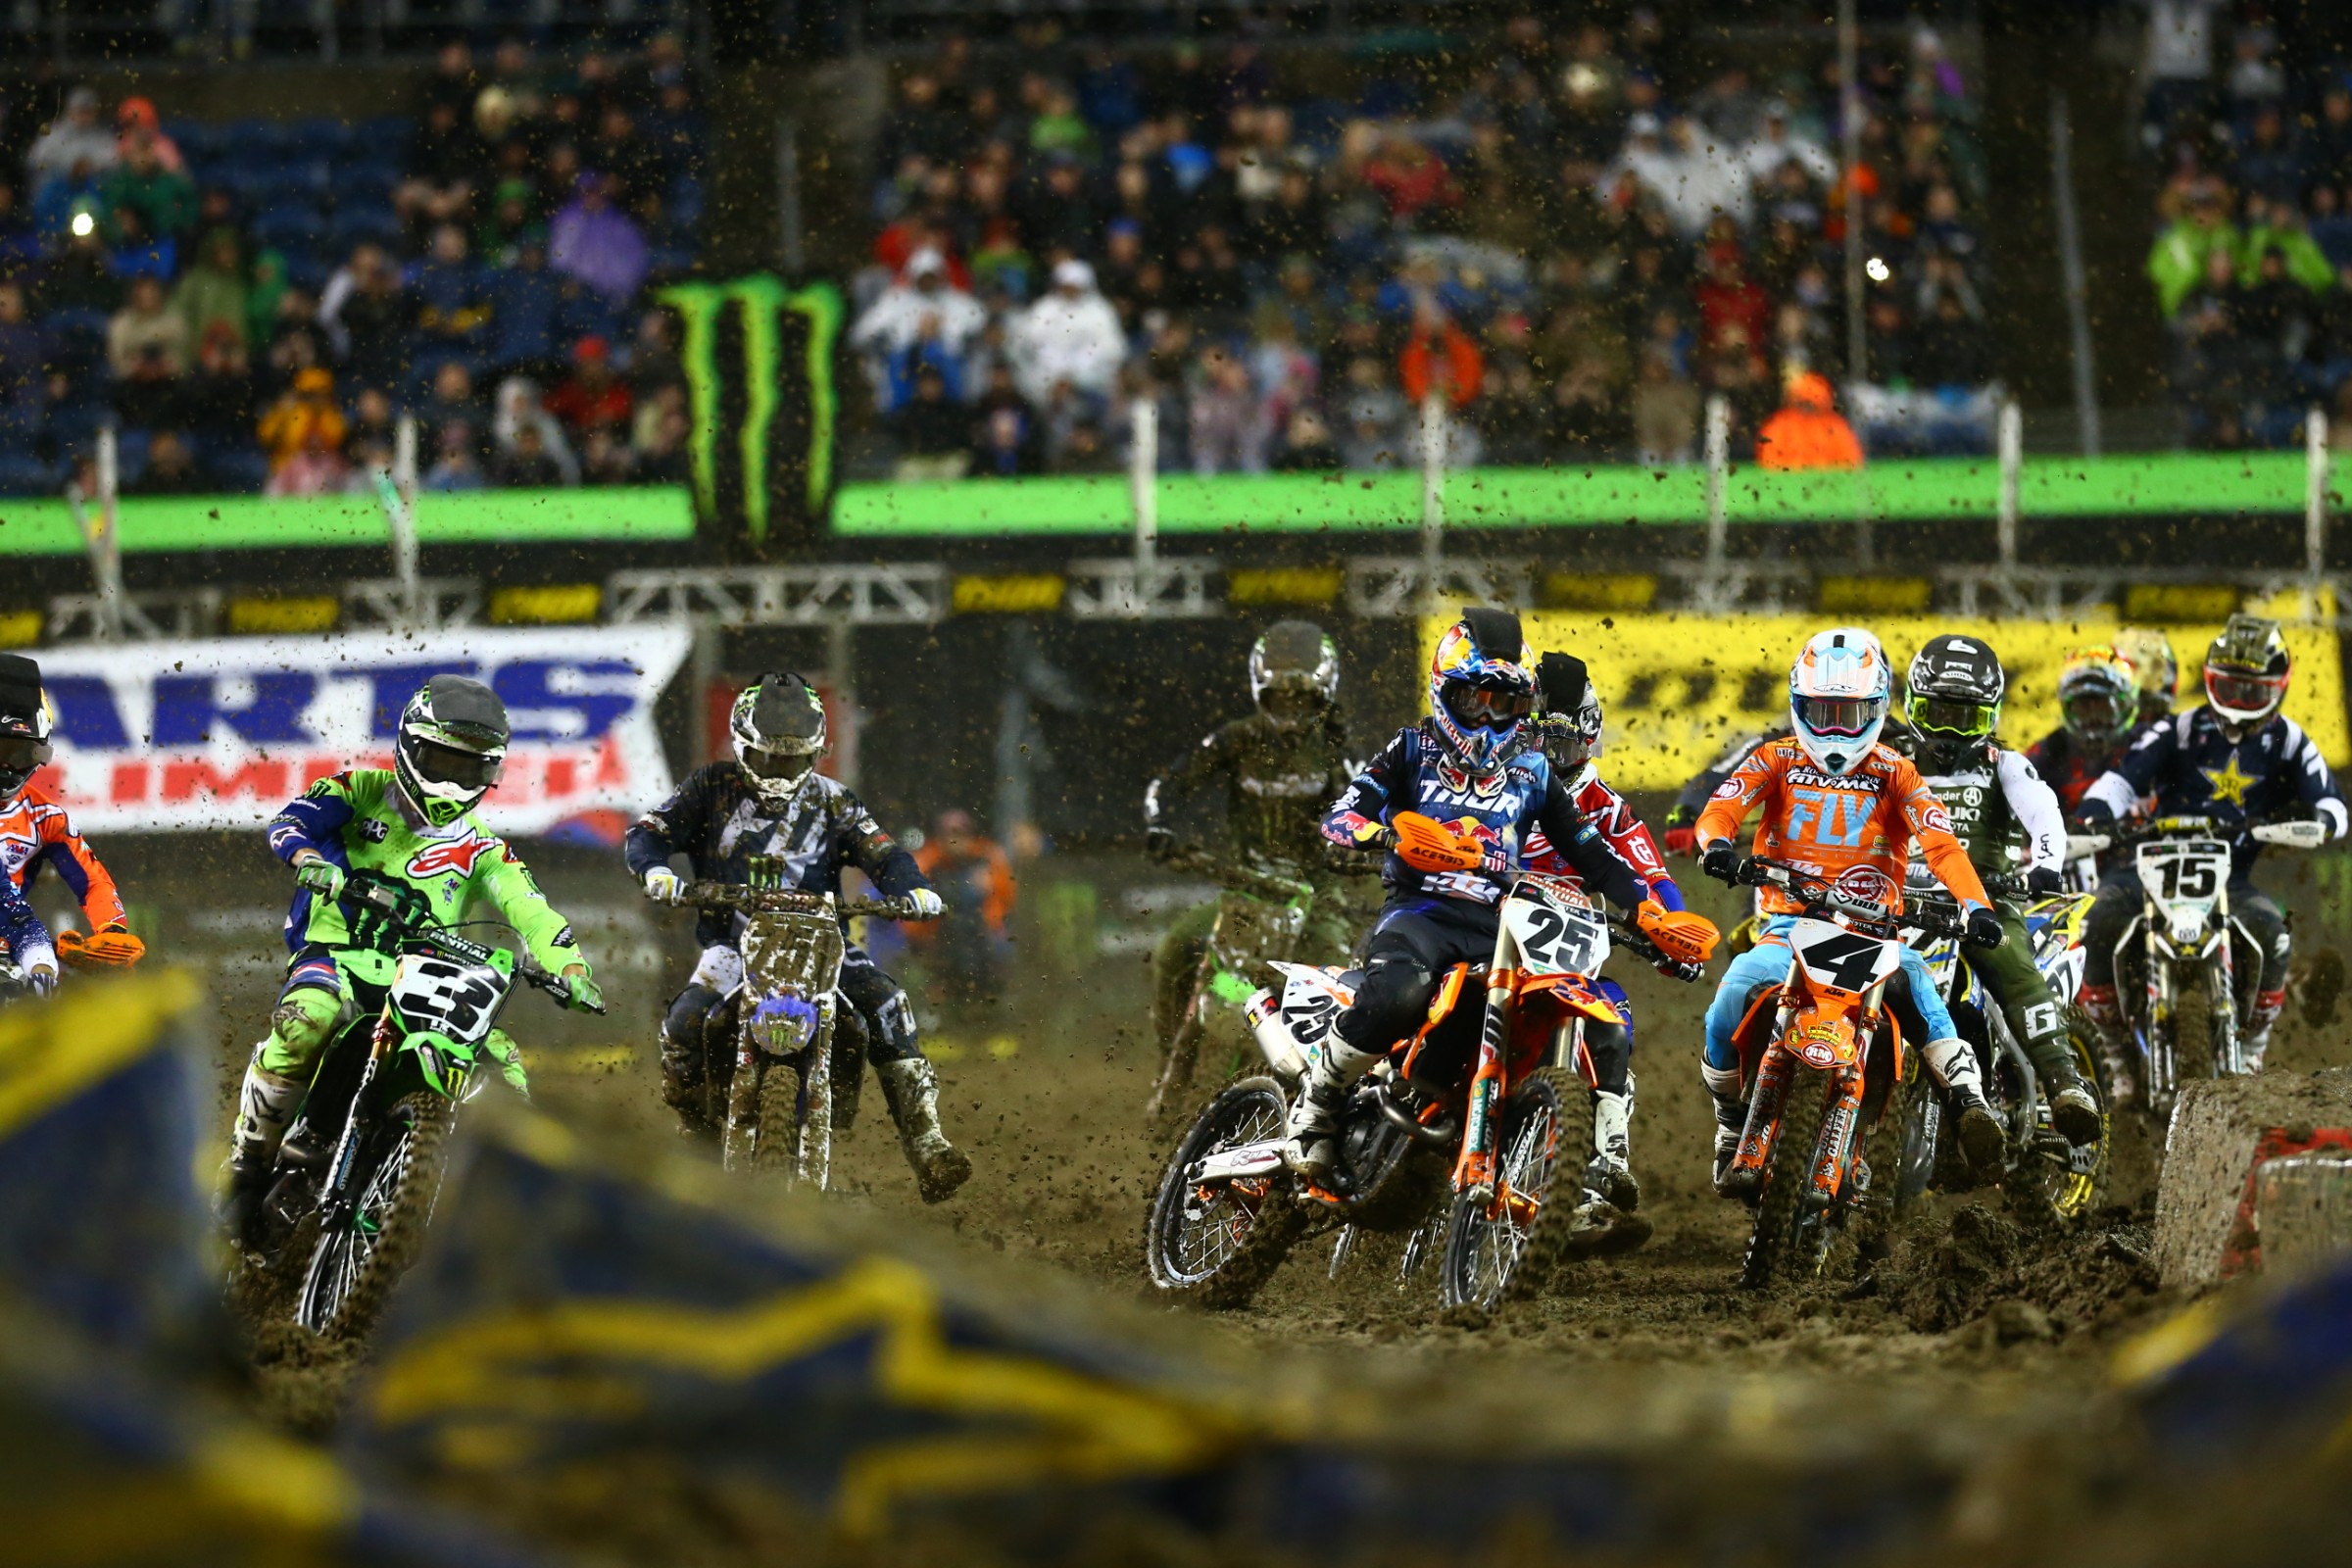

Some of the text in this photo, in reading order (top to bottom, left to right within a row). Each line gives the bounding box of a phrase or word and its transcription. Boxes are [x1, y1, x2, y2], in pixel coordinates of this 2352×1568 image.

[359, 817, 389, 840] PPG
[1787, 788, 1877, 847] FLY
[1409, 846, 1467, 867] ACERBIS
[2155, 857, 2218, 900] 15
[1522, 907, 1599, 975] 25
[1649, 926, 1703, 956] ACERBIS
[1800, 932, 1885, 993] 4
[398, 961, 495, 1033] 3
[1824, 987, 1846, 999] KTM
[1281, 994, 1343, 1046] 25
[1806, 1045, 1832, 1061] RM
[1466, 1098, 1484, 1152] MOTOREX
[1827, 1106, 1848, 1158] GALFER
